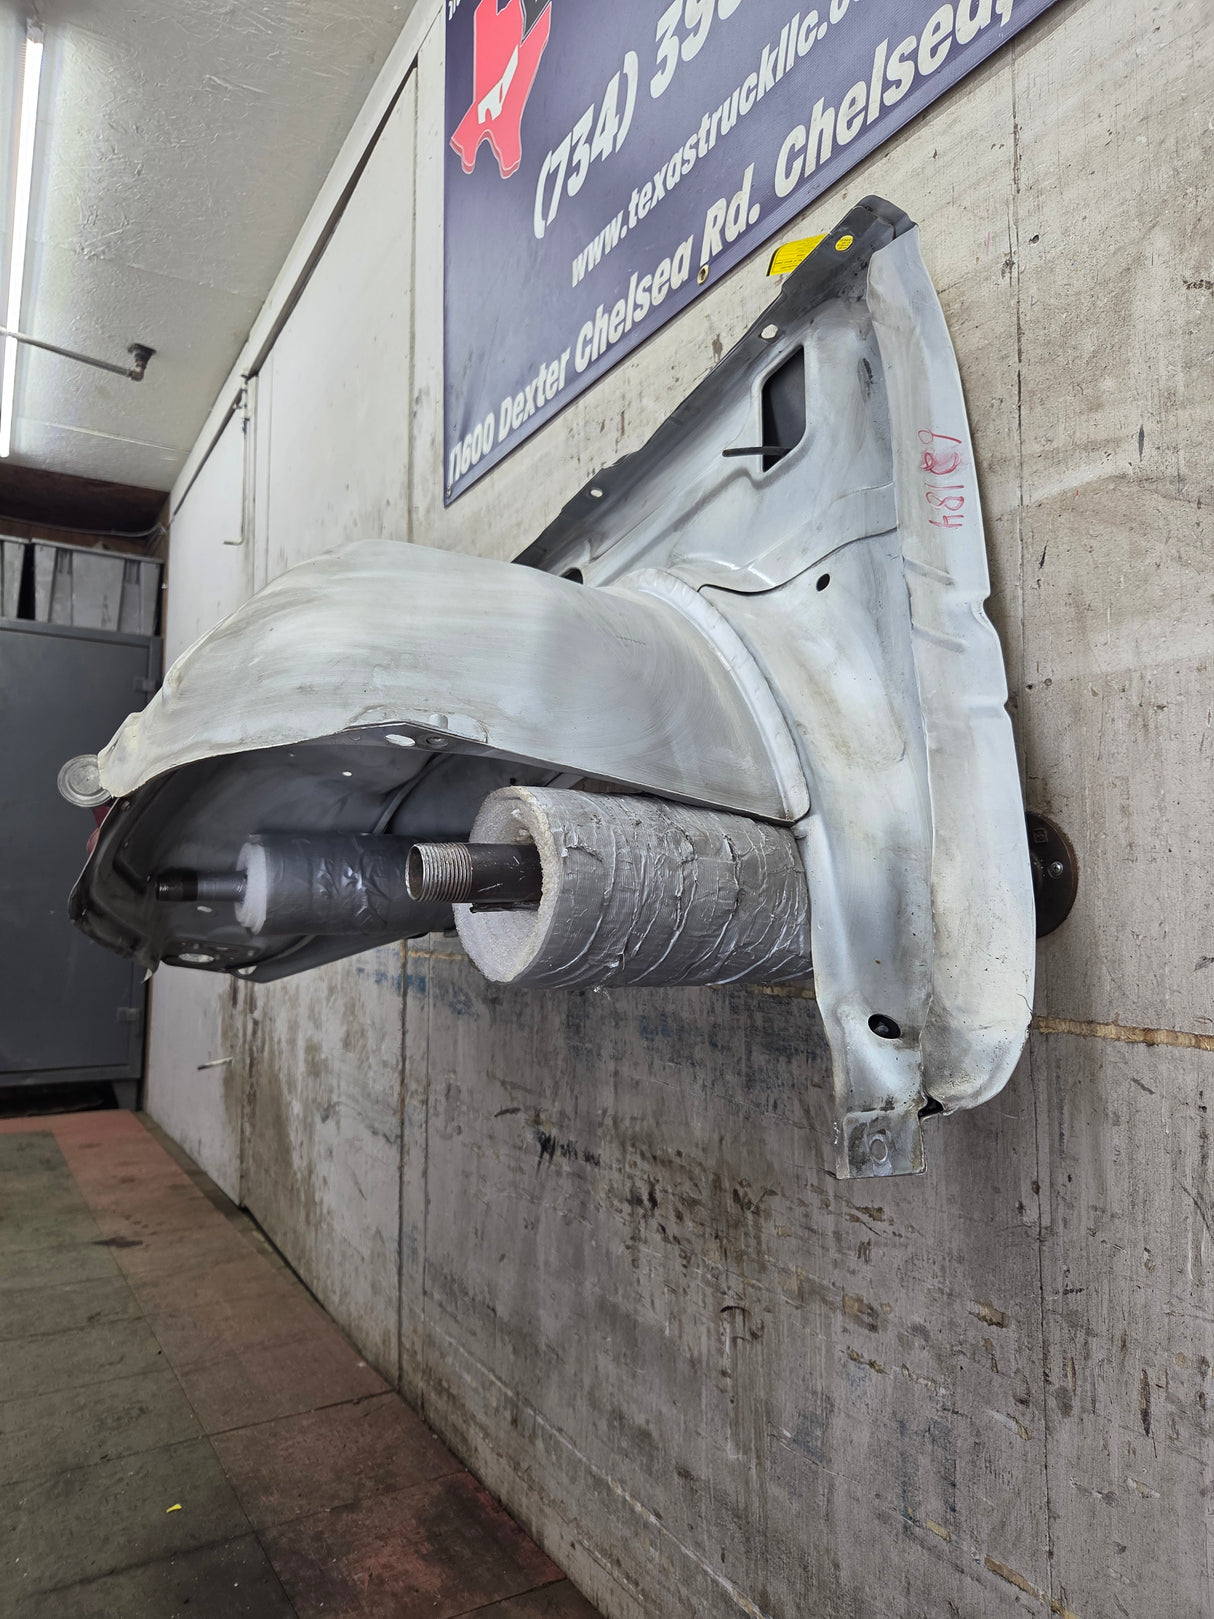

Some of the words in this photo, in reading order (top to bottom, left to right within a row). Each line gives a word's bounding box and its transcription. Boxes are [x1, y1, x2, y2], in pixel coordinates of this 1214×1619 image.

[534, 51, 639, 240] (734)
[498, 345, 572, 444] Dexter
[575, 234, 694, 373] Chelsea
[700, 161, 761, 267] Rd.
